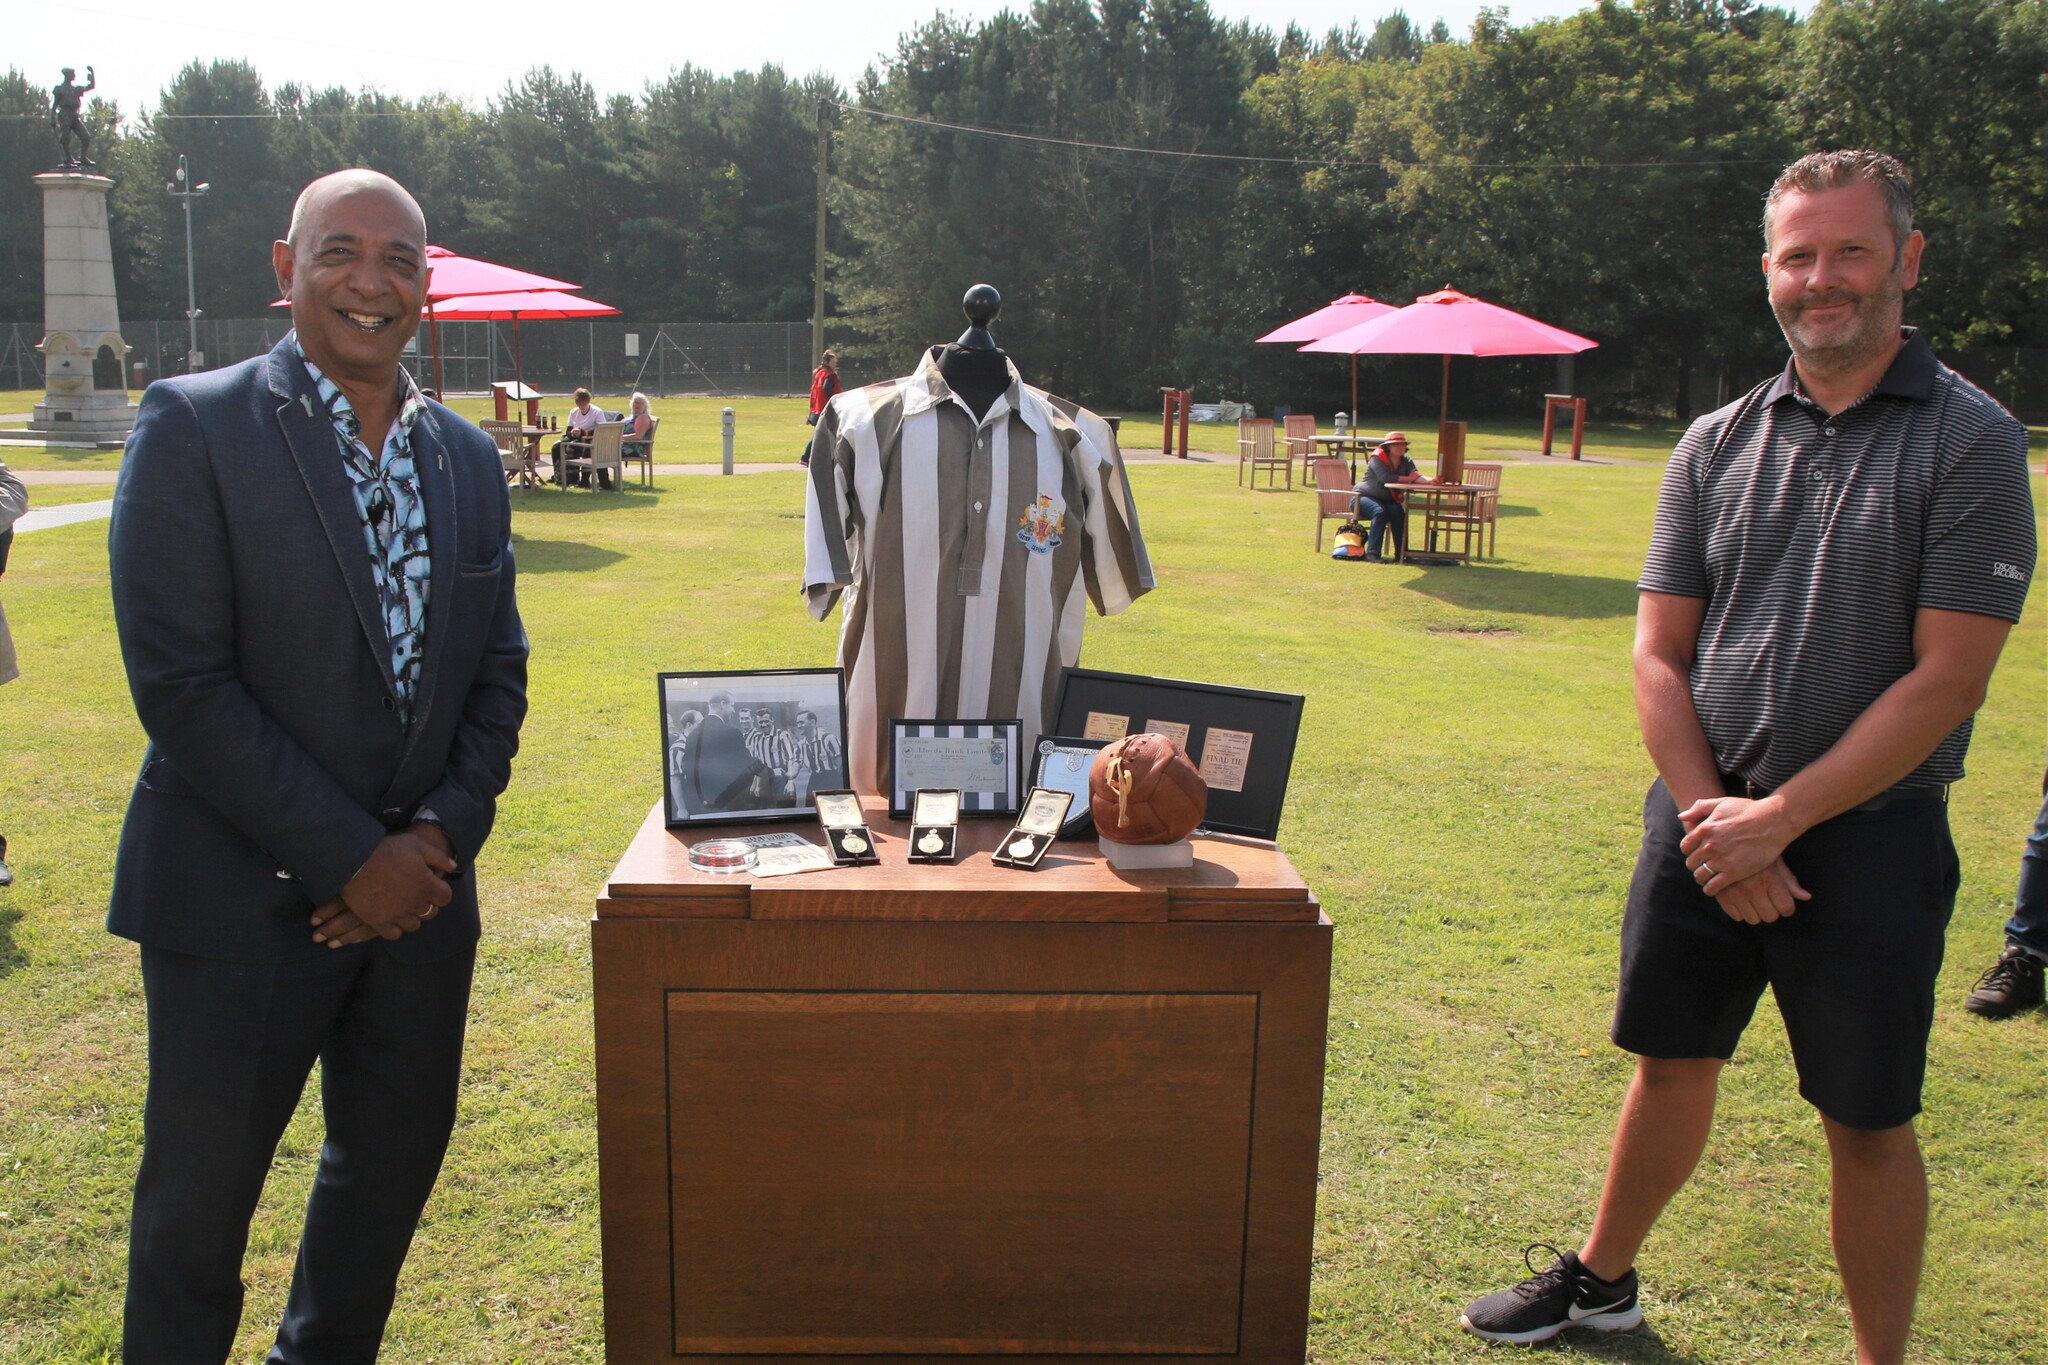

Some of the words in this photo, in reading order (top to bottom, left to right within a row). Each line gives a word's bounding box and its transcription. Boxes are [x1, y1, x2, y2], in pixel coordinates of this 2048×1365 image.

[1994, 562, 2017, 572] OSCAR
[1206, 755, 1228, 763] FINAL
[1231, 757, 1243, 765] TIE
